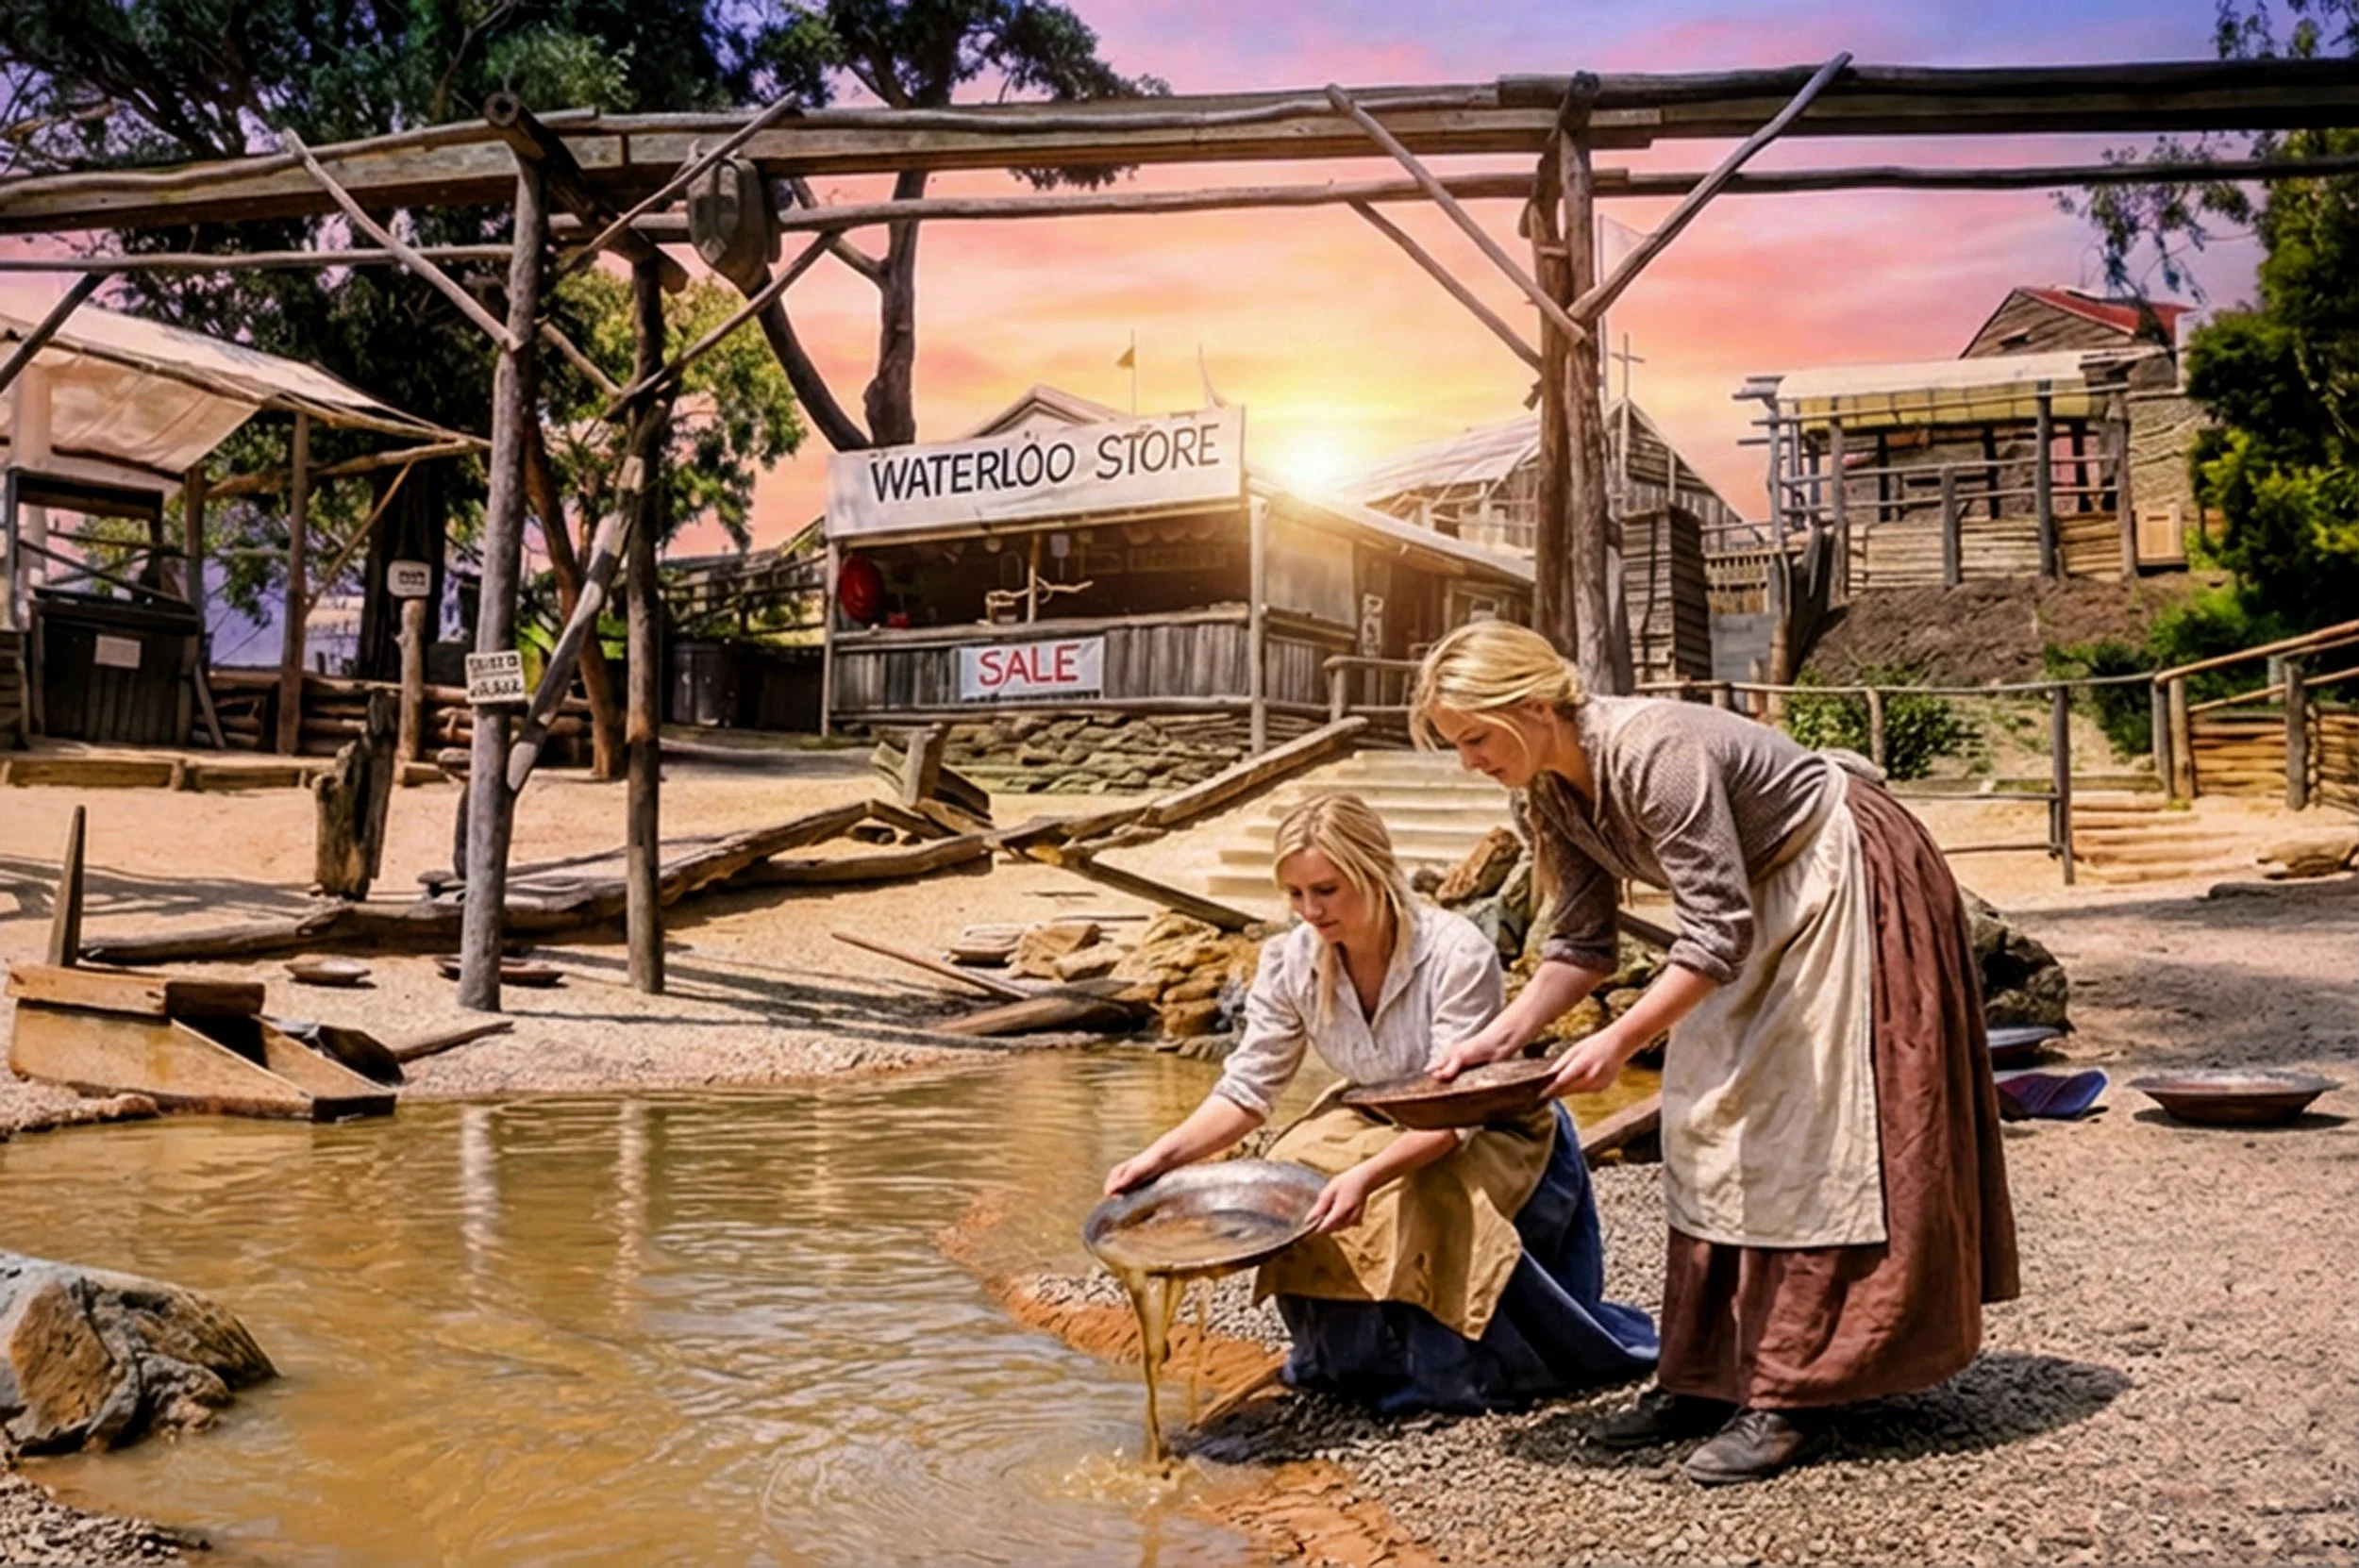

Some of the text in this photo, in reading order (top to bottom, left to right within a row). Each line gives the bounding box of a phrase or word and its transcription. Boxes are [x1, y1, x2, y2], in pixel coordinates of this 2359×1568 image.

[871, 424, 1220, 503] WATERLOO STORE
[979, 643, 1081, 688] SALE
